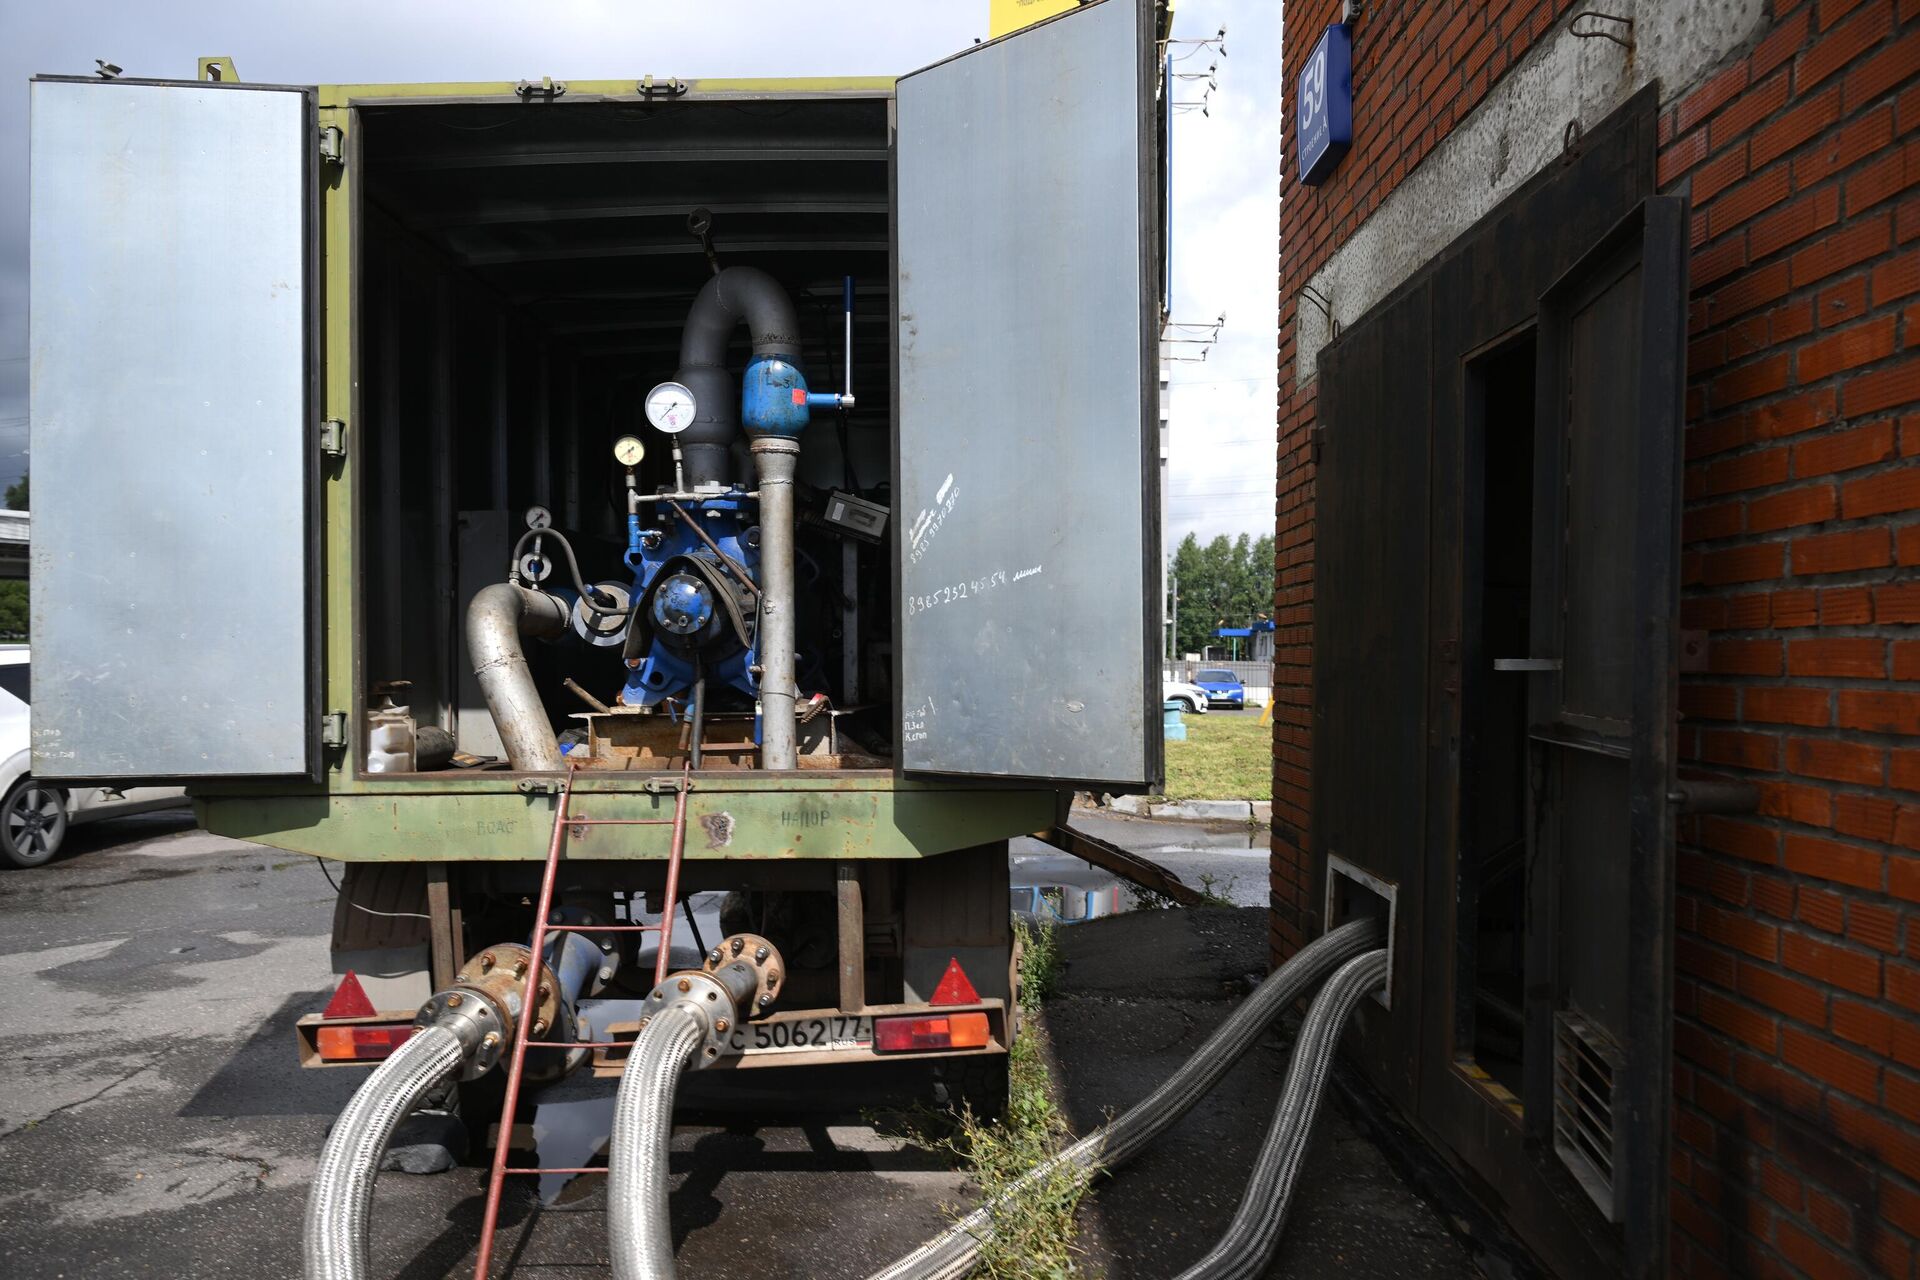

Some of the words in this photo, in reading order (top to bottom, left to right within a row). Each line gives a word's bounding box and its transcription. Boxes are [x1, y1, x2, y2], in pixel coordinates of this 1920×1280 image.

[1303, 51, 1324, 130] 59
[1302, 126, 1322, 161] СТРОЕНИЕ
[755, 1019, 827, 1049] 5062
[834, 1017, 862, 1038] 77
[834, 1037, 857, 1046] RUS
